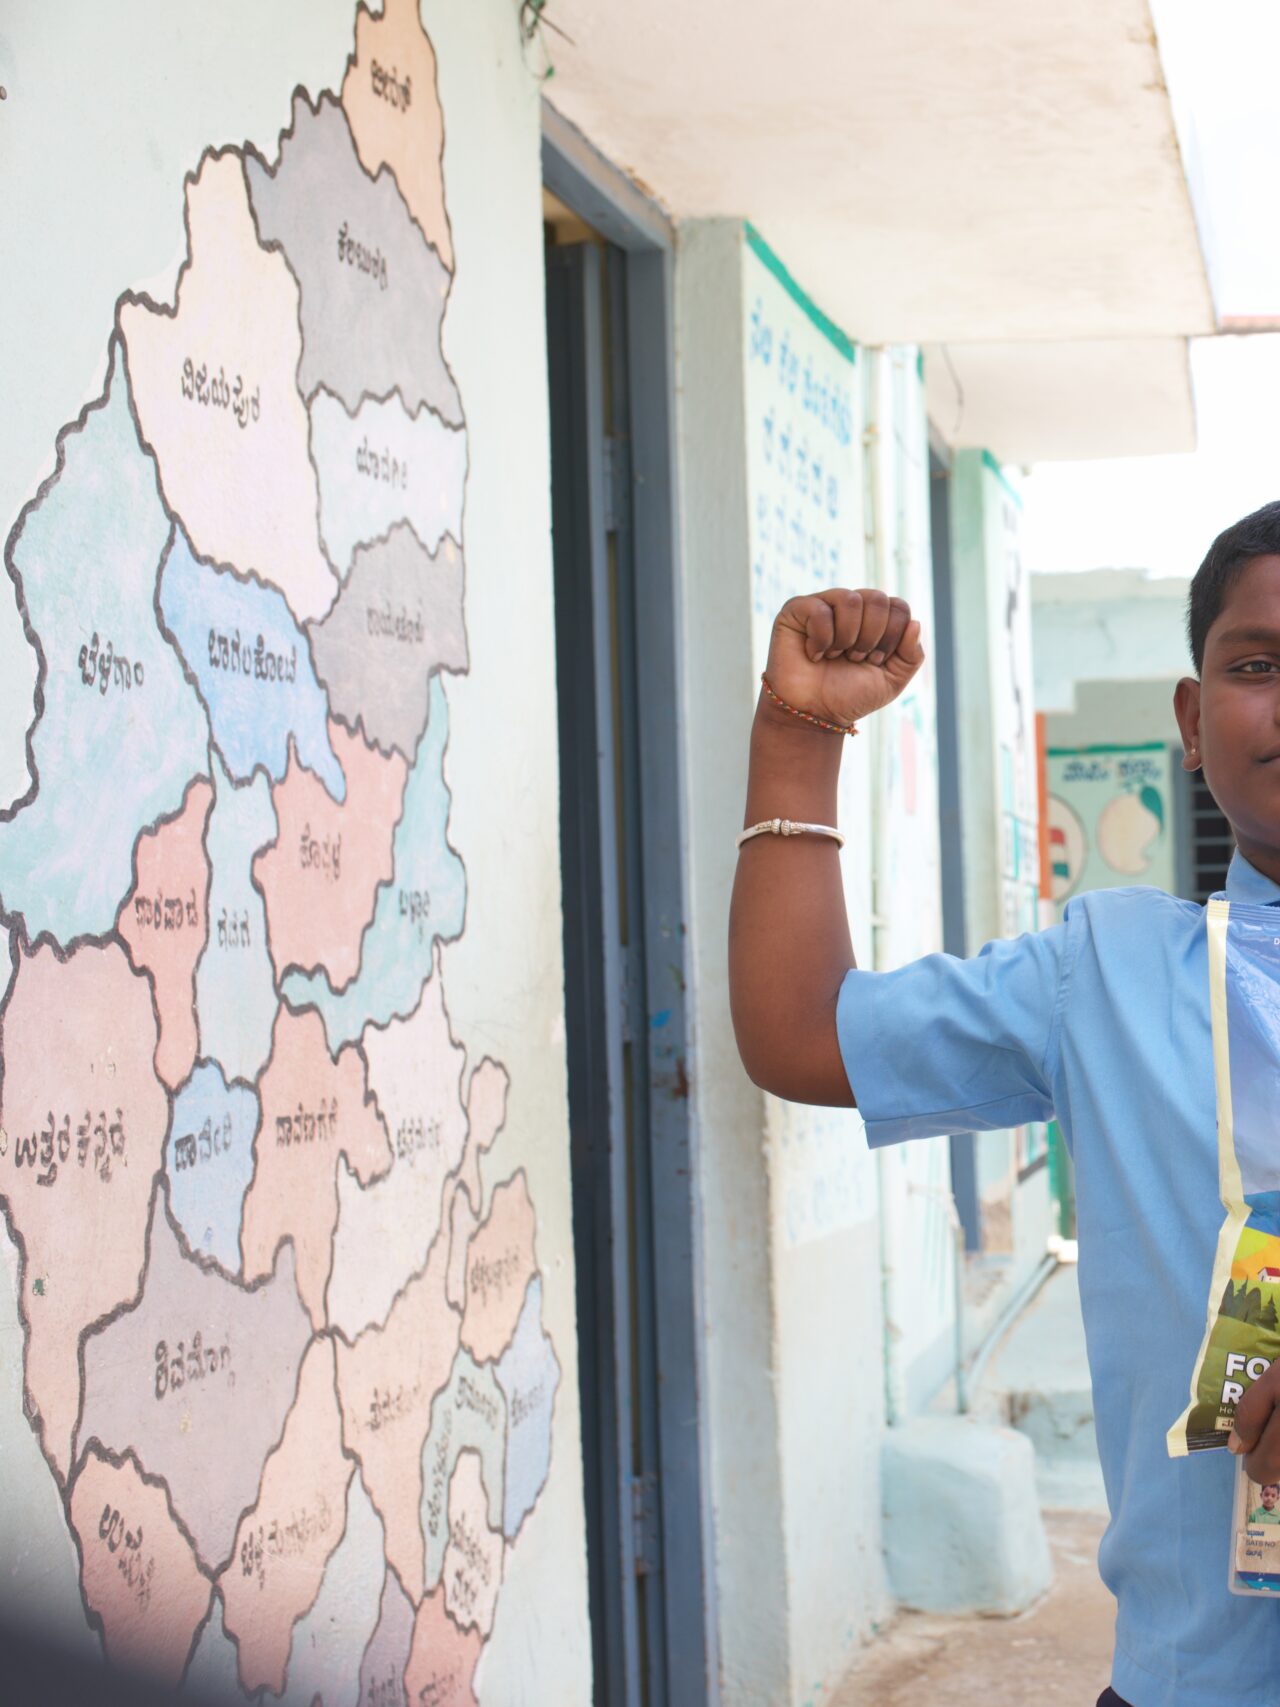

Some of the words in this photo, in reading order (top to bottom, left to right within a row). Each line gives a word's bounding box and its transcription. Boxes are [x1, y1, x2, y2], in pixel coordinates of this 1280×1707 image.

[181, 357, 260, 430] ವಿಜಯಪುರ
[1225, 1352, 1272, 1381] FO
[1221, 1380, 1244, 1405] R
